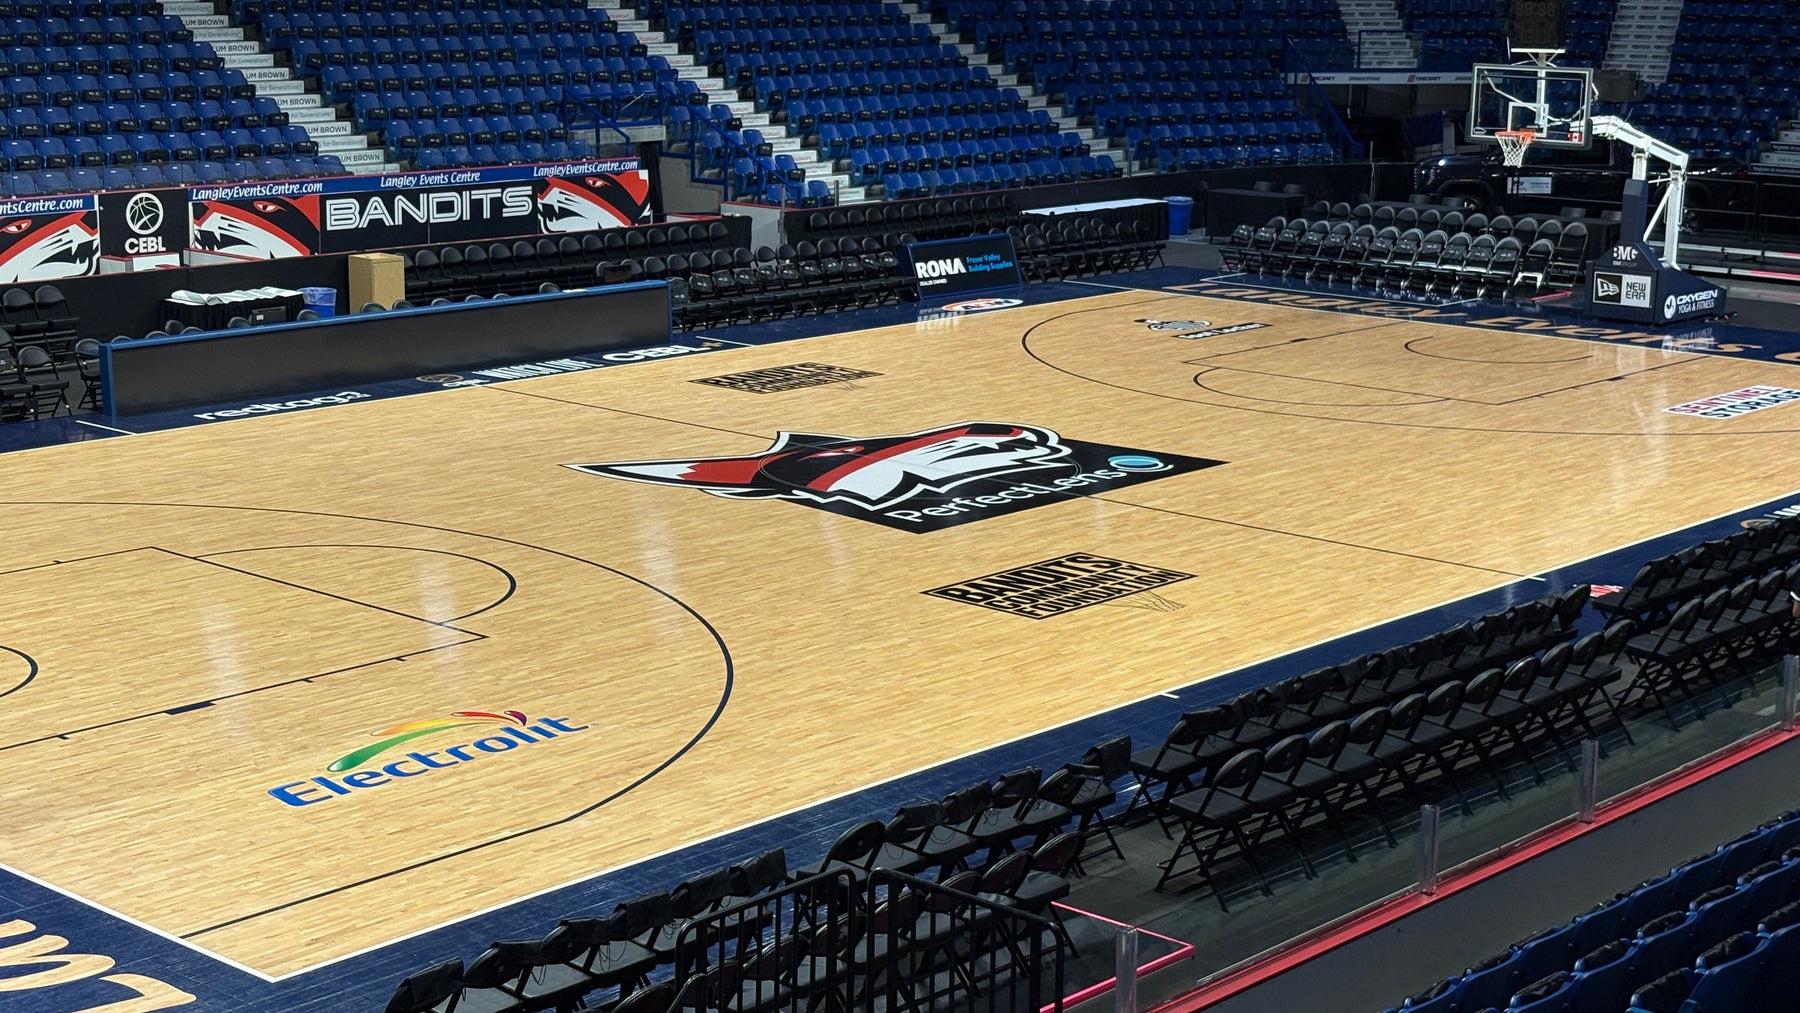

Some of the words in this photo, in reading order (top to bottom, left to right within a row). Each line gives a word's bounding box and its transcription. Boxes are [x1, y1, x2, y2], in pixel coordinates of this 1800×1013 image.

[228, 44, 255, 52] BROWN
[352, 154, 380, 162] BROWN
[533, 160, 638, 177] LangleyEventsCentre.com
[380, 174, 418, 188] Langley
[420, 172, 449, 186] Events
[450, 170, 480, 183] Centre
[192, 181, 323, 200] LangleyEventsCentre.com
[326, 186, 532, 231] BANDITS
[125, 236, 166, 254] CEBL
[983, 252, 1000, 262] Valley
[915, 258, 966, 278] RONA
[1625, 291, 1646, 300] ERA
[1626, 282, 1646, 292] NEW
[1676, 290, 1718, 304] OXYGEN
[1678, 304, 1692, 314] YOGA
[1692, 302, 1696, 311] &
[1696, 300, 1714, 310] FITNESS
[1466, 316, 1763, 353] Events
[1668, 387, 1782, 413] SENTINEL
[883, 468, 1128, 522] PerfectLens
[930, 555, 1123, 601] BANDITS
[983, 564, 1154, 613] COMMUNITY
[1010, 570, 1184, 618] FOUNDATION
[267, 716, 589, 807] Electrolit
